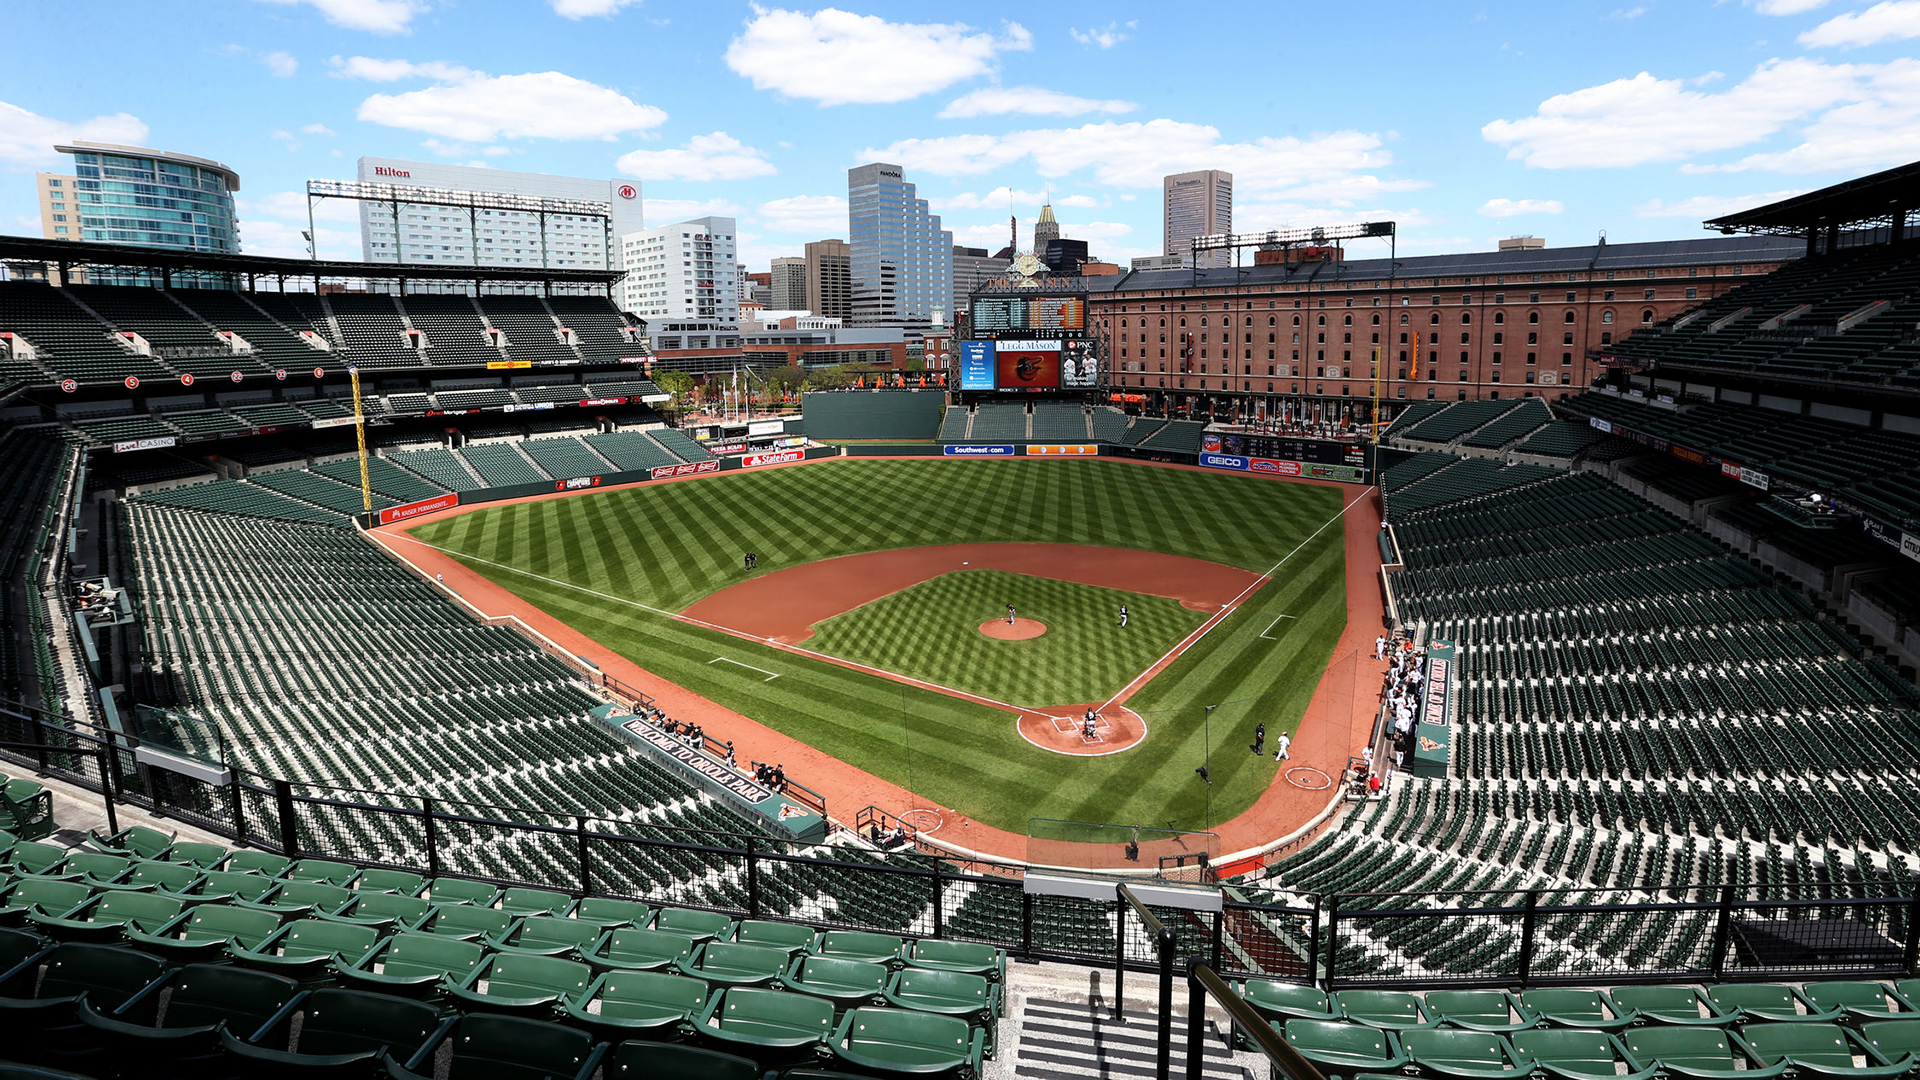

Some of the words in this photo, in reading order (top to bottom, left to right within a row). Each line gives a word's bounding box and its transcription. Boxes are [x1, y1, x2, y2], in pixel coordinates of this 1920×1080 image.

[374, 166, 410, 178] Hilton
[987, 278, 1011, 288] THE
[1046, 277, 1070, 288] SUN
[1002, 342, 1024, 350] LEGG
[1026, 342, 1056, 350] MASON
[115, 440, 139, 452] Live!
[140, 438, 174, 448] CASINO
[762, 454, 780, 464] State
[780, 453, 798, 461] Farm
[1207, 456, 1241, 466] GEICO
[401, 508, 417, 517] KAISER
[1426, 703, 1443, 724] HOME
[627, 722, 676, 750] WELCOME
[672, 746, 695, 759] TO
[689, 756, 732, 783] ORIOLE
[727, 779, 767, 802] PARK
